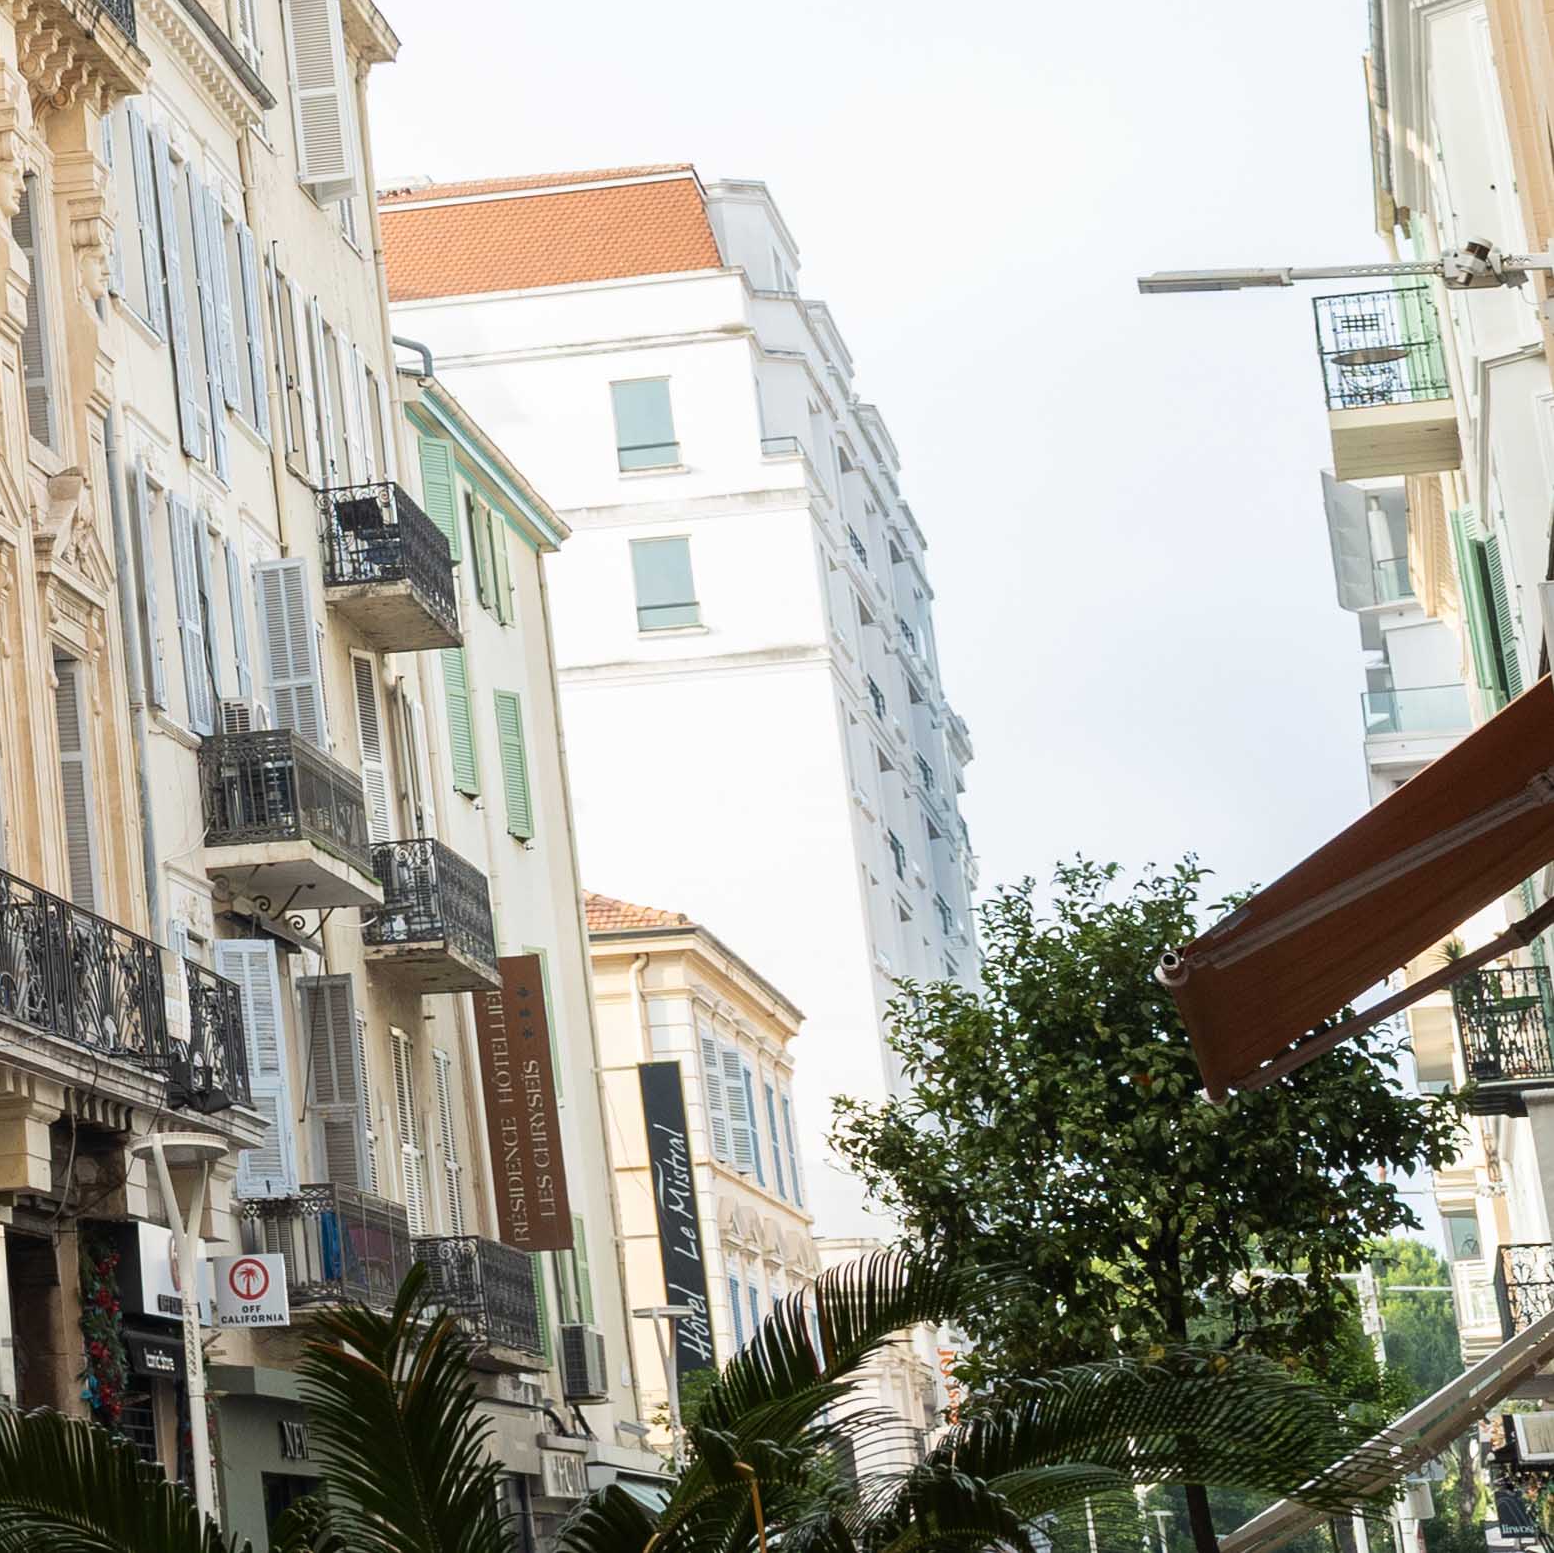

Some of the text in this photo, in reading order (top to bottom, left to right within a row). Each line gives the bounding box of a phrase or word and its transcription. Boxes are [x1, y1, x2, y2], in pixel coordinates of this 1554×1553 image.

[483, 991, 530, 1244] RÉSIDENCE HÔTELLIÈ
[653, 1123, 694, 1220] Mistral
[538, 1174, 557, 1219] LES
[673, 1226, 701, 1261] Le
[221, 1315, 284, 1324] CALIFORNIA
[242, 1305, 261, 1313] OFF
